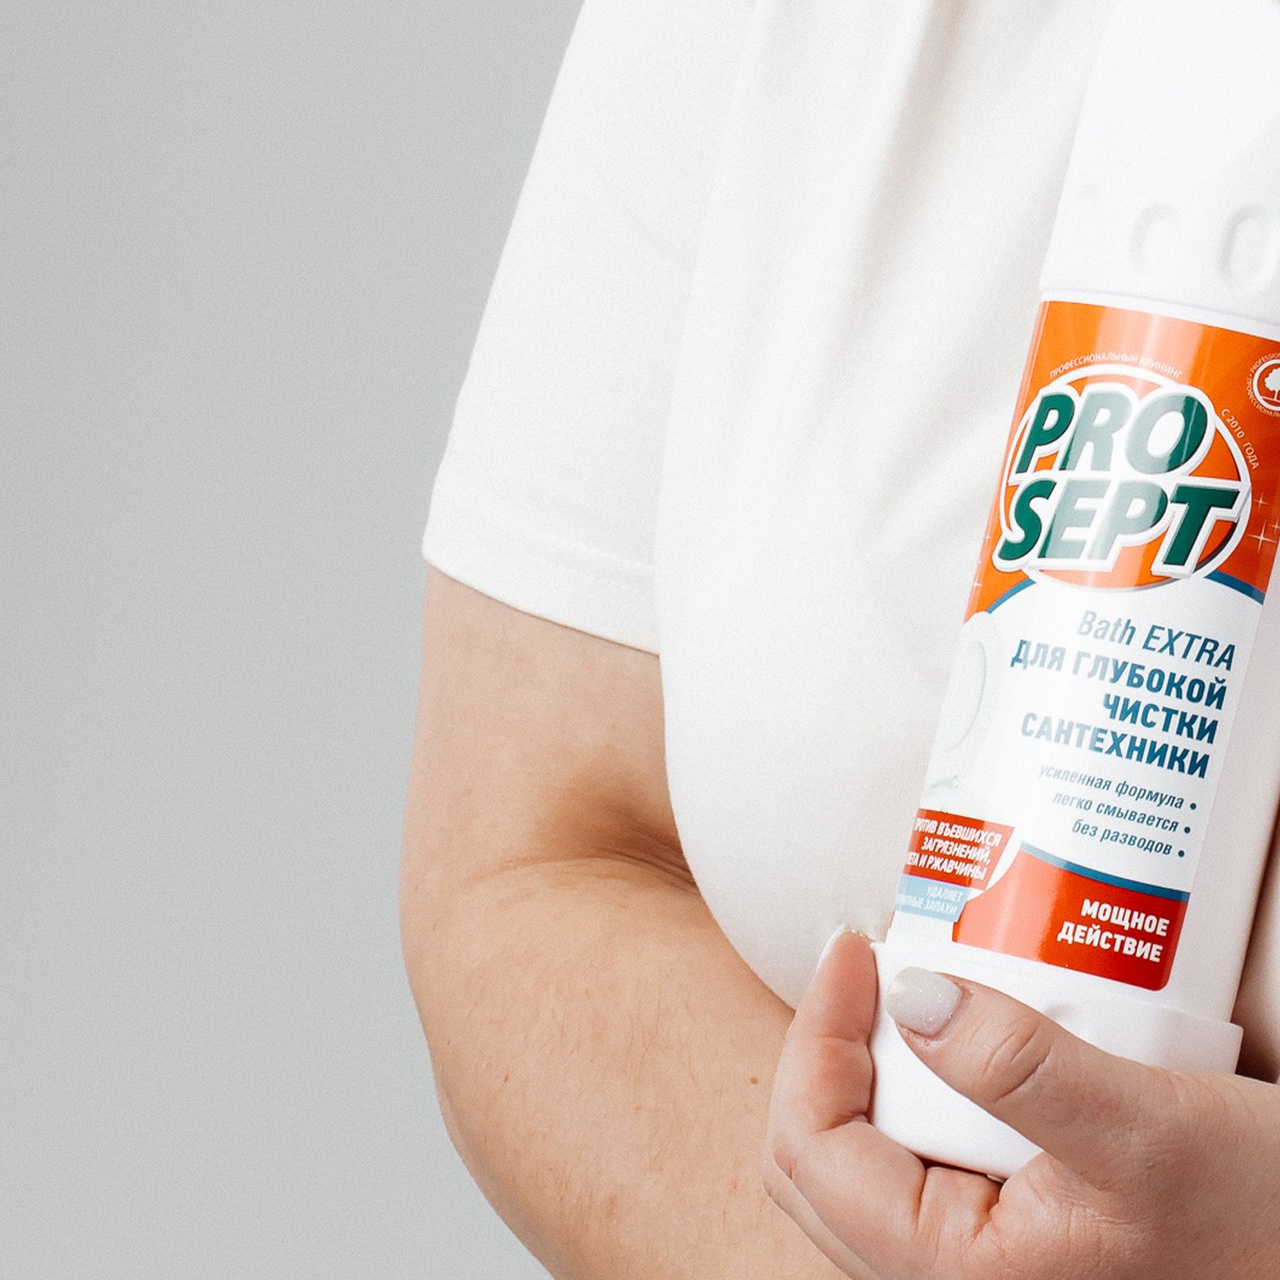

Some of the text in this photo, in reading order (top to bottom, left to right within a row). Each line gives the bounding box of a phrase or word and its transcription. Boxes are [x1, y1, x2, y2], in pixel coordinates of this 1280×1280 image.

[1049, 351, 1184, 379] ПРОФЕССИОНАЛЬНЫЙ КЛИНИНГ
[1014, 391, 1210, 477] PRO
[1226, 415, 1246, 439] 2010
[1242, 441, 1260, 470] ГОДА
[996, 477, 1242, 568] SEPT
[1076, 609, 1236, 671] Bath EXTRA
[1010, 638, 1228, 711] ДЛЯ ГЛУБОКОЙ
[1102, 693, 1219, 745] ЧИСТКИ
[1020, 712, 1211, 779] САНТЕХНИКИ
[1038, 765, 1185, 810] усиленная формула
[937, 821, 1003, 848] ВЪЕВШИХСЯ
[1052, 791, 1180, 833] легко смывается
[1072, 818, 1173, 856] без разводов
[918, 853, 928, 868] И
[925, 854, 988, 881] РЖАВЧИНЫ
[1080, 898, 1170, 936] МОЩНОЕ
[1056, 921, 1164, 963] ДЕЙСТВИЕ
